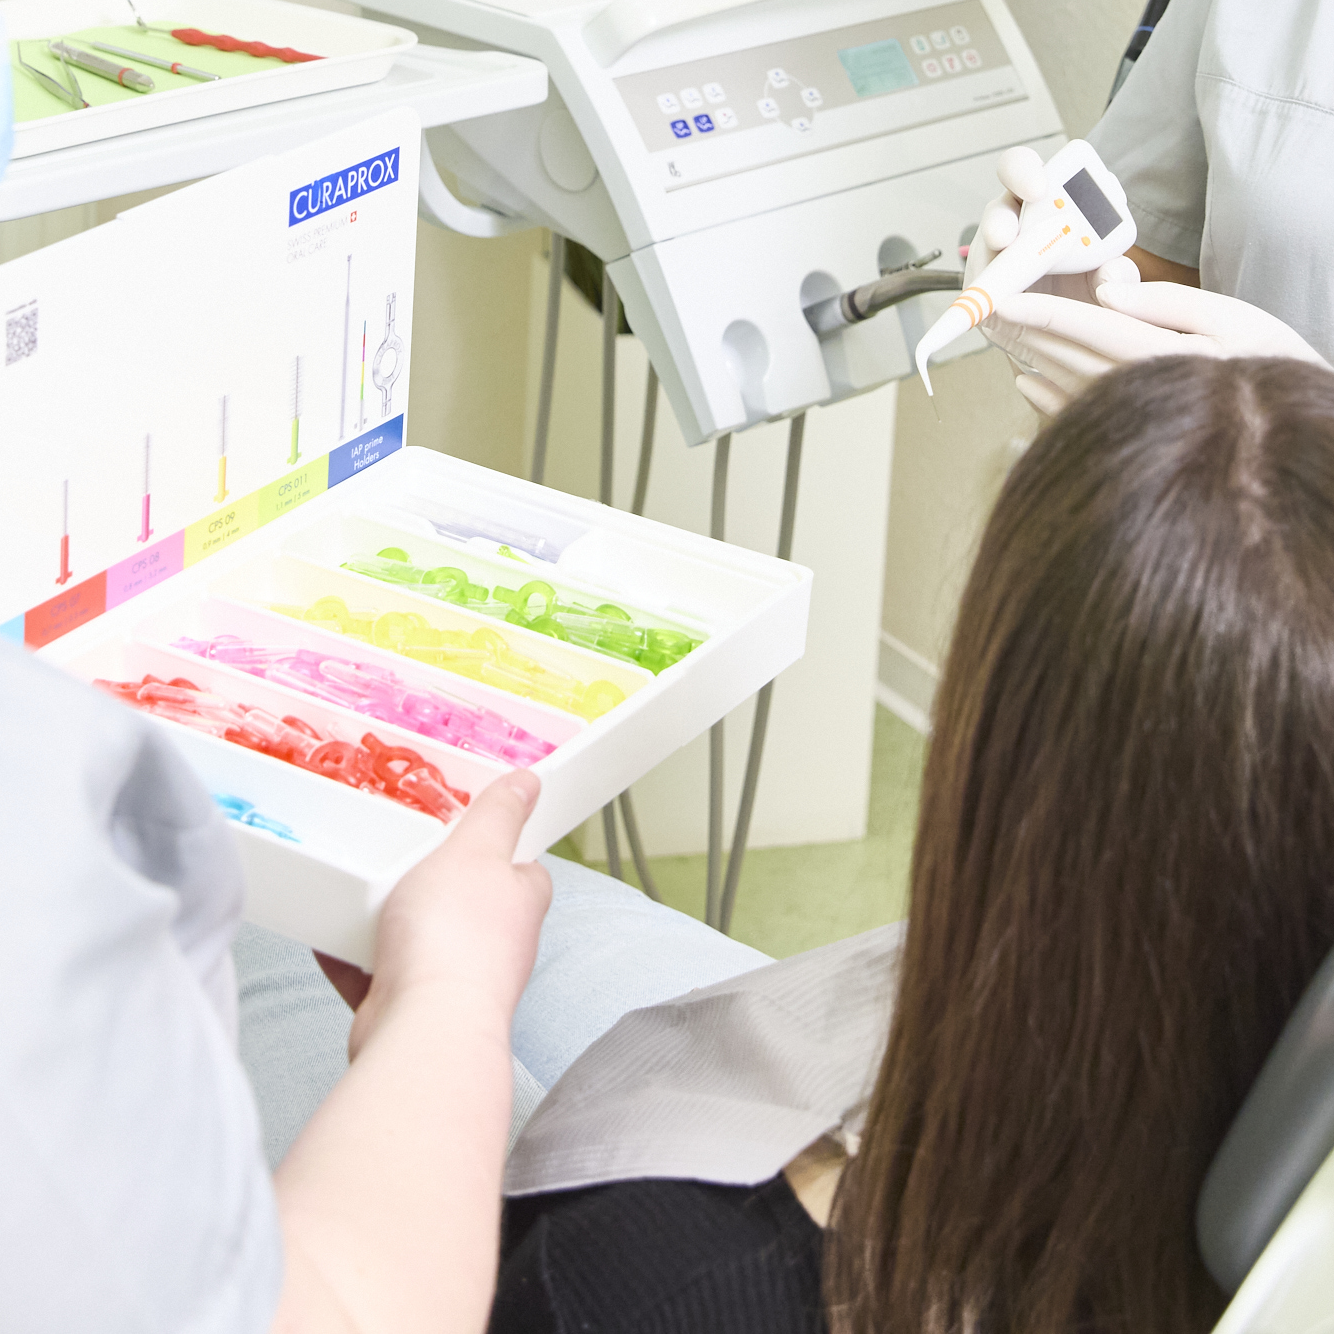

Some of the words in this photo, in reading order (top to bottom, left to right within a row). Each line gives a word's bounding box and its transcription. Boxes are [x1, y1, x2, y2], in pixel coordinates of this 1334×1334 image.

[292, 153, 396, 219] CURAPROX
[351, 444, 364, 459] IAP
[364, 435, 384, 453] prime
[354, 451, 380, 471] Holders
[278, 481, 293, 497] CPS
[294, 473, 308, 489] 011
[208, 517, 223, 534] CPS
[224, 510, 236, 525] 09
[131, 557, 147, 574] CPS
[149, 551, 160, 565] 08
